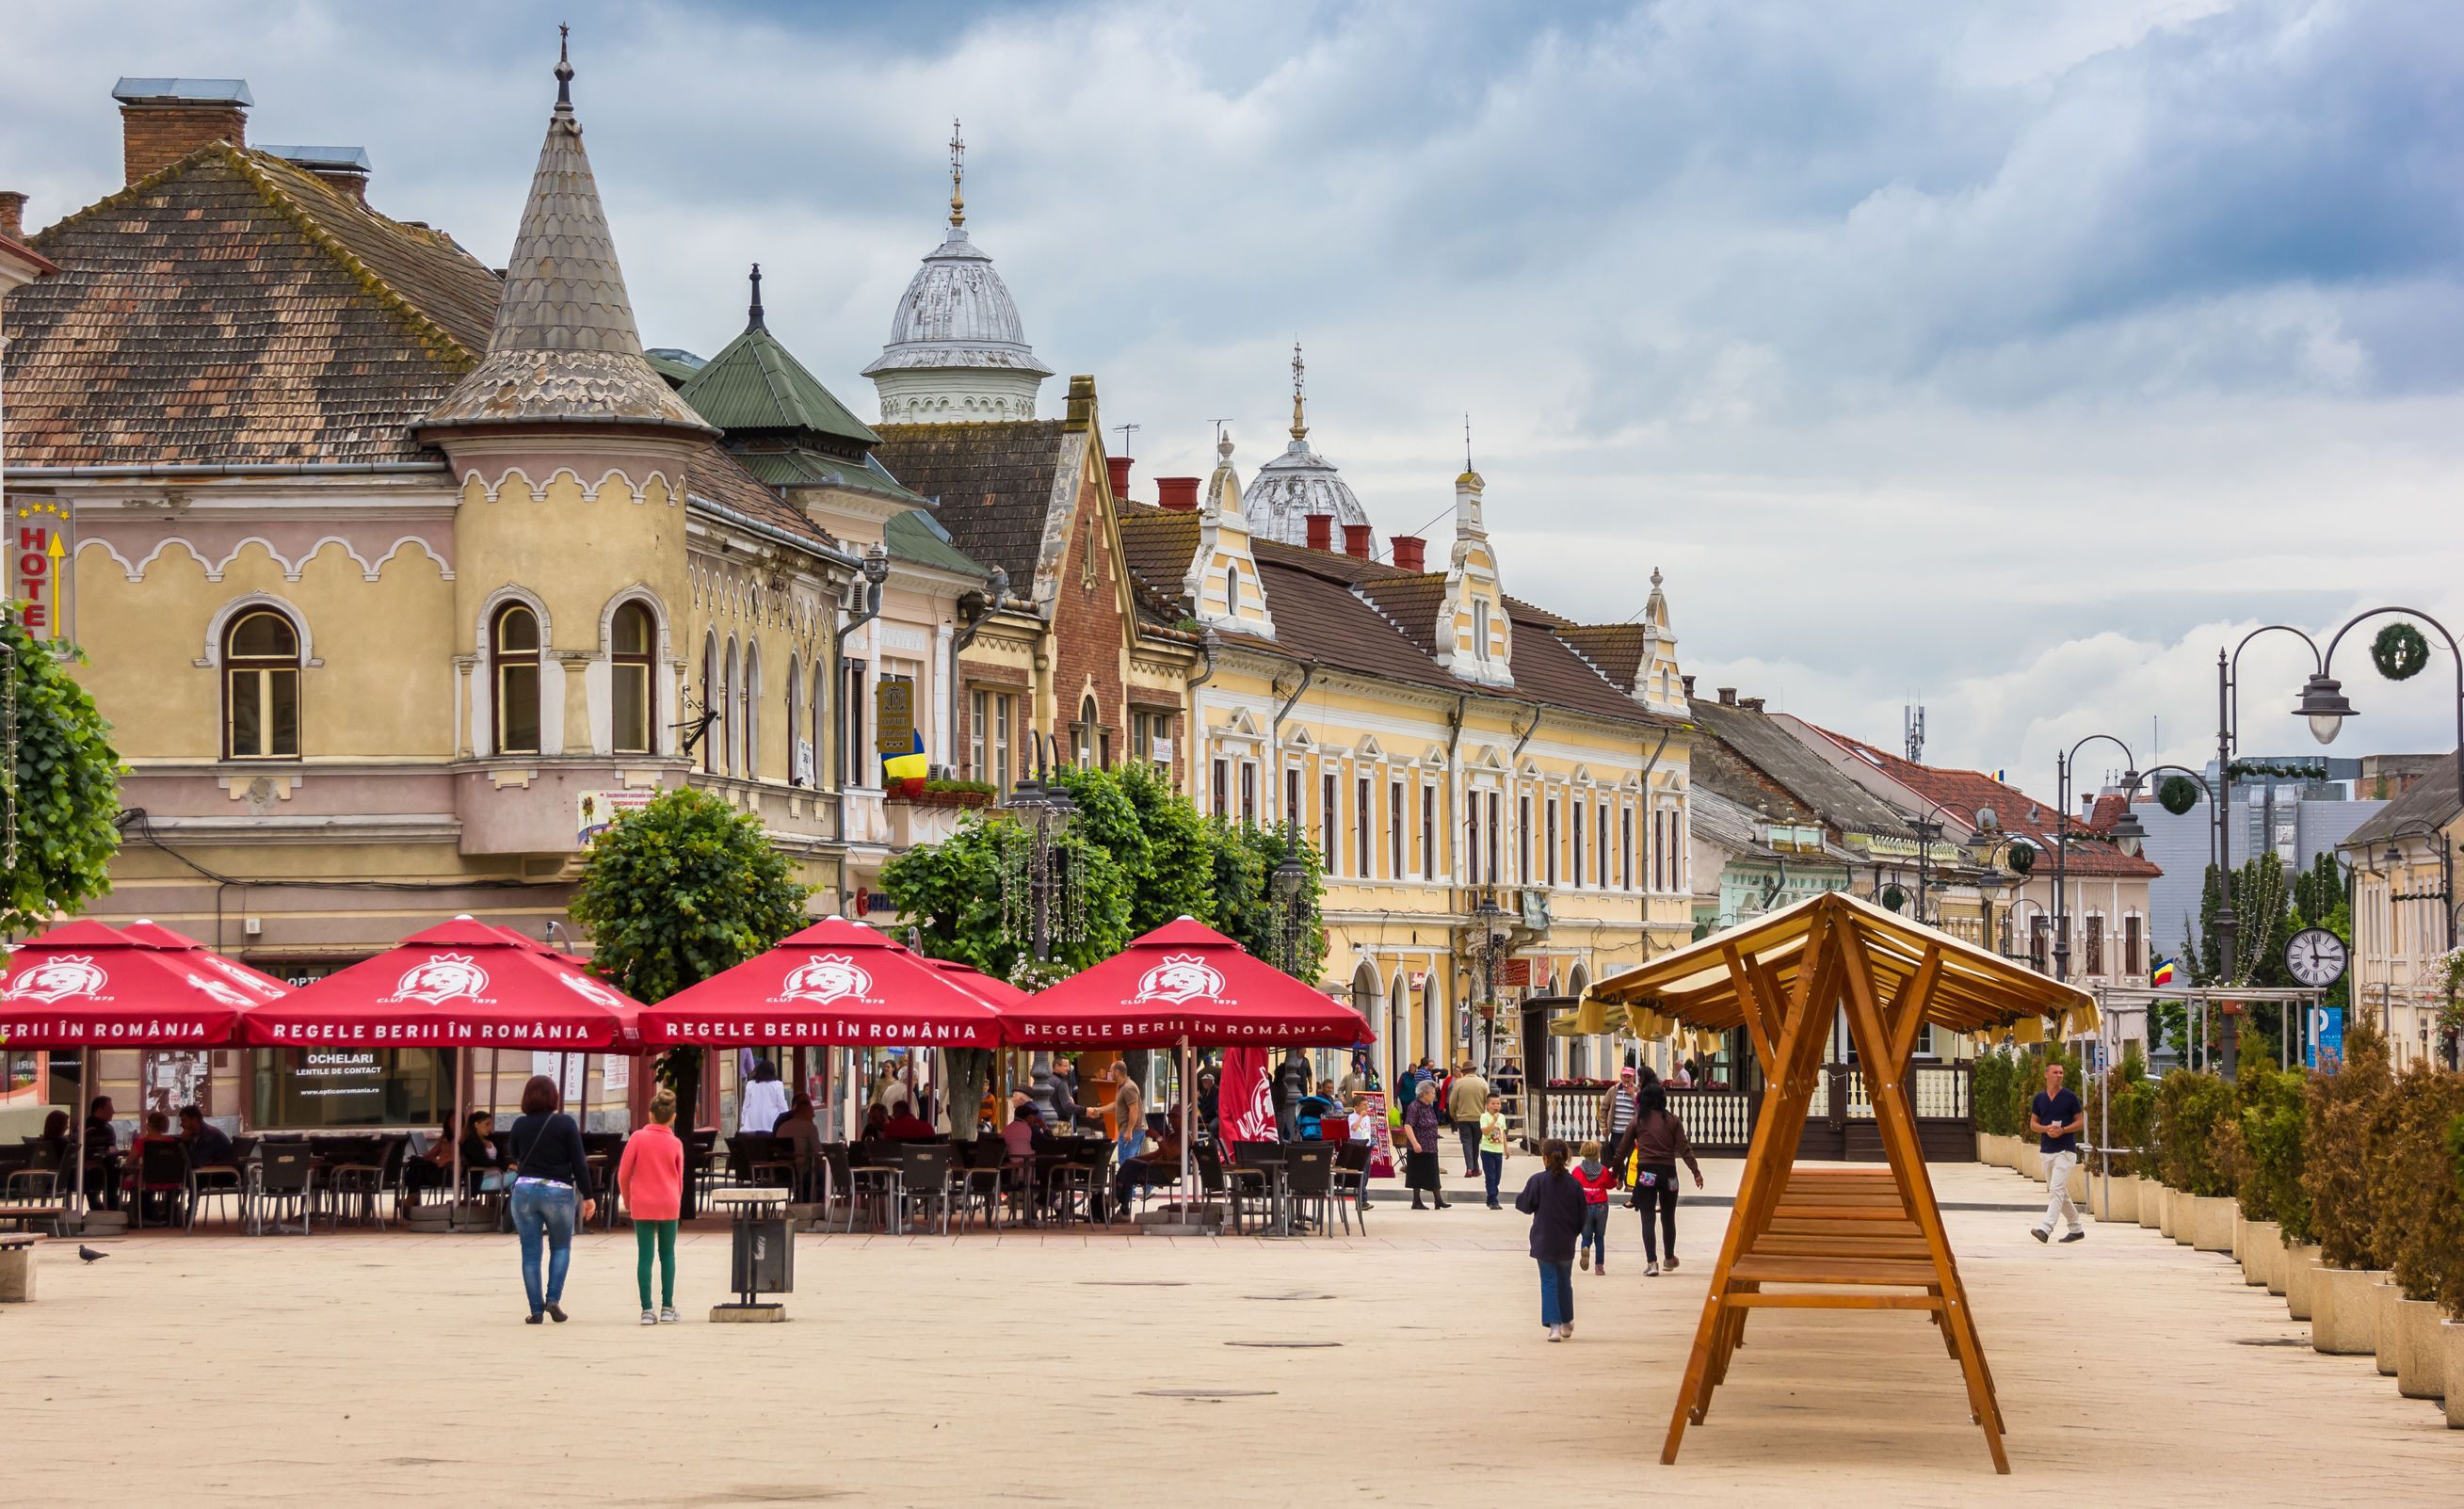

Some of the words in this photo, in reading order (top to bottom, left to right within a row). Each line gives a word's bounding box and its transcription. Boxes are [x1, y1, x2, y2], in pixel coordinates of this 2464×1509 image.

[287, 977, 321, 987] OPT
[0, 1023, 49, 1036] ERII
[60, 1020, 84, 1036] ÎN
[94, 1020, 205, 1036] ROMÂNIA
[273, 1024, 365, 1038] REGELE
[375, 1025, 439, 1039] BERII
[448, 1021, 472, 1037] ÎN
[482, 1022, 589, 1038] ROMÂNIA
[666, 1022, 755, 1036] REGELE
[765, 1023, 828, 1036] BERII
[837, 1020, 860, 1037] ÎN
[870, 1022, 976, 1038] ROMÂNIA
[1024, 1023, 1112, 1036] REGELE
[1122, 1021, 1184, 1035] BERII
[1194, 1021, 1216, 1033] ÎN
[1227, 1023, 1332, 1035] ROMÂNIA
[307, 1053, 374, 1064] OCHELARI
[296, 1068, 330, 1076] LENTILE
[344, 1067, 382, 1075] CONTACT
[300, 1087, 379, 1096] www.opticonromania.ro
